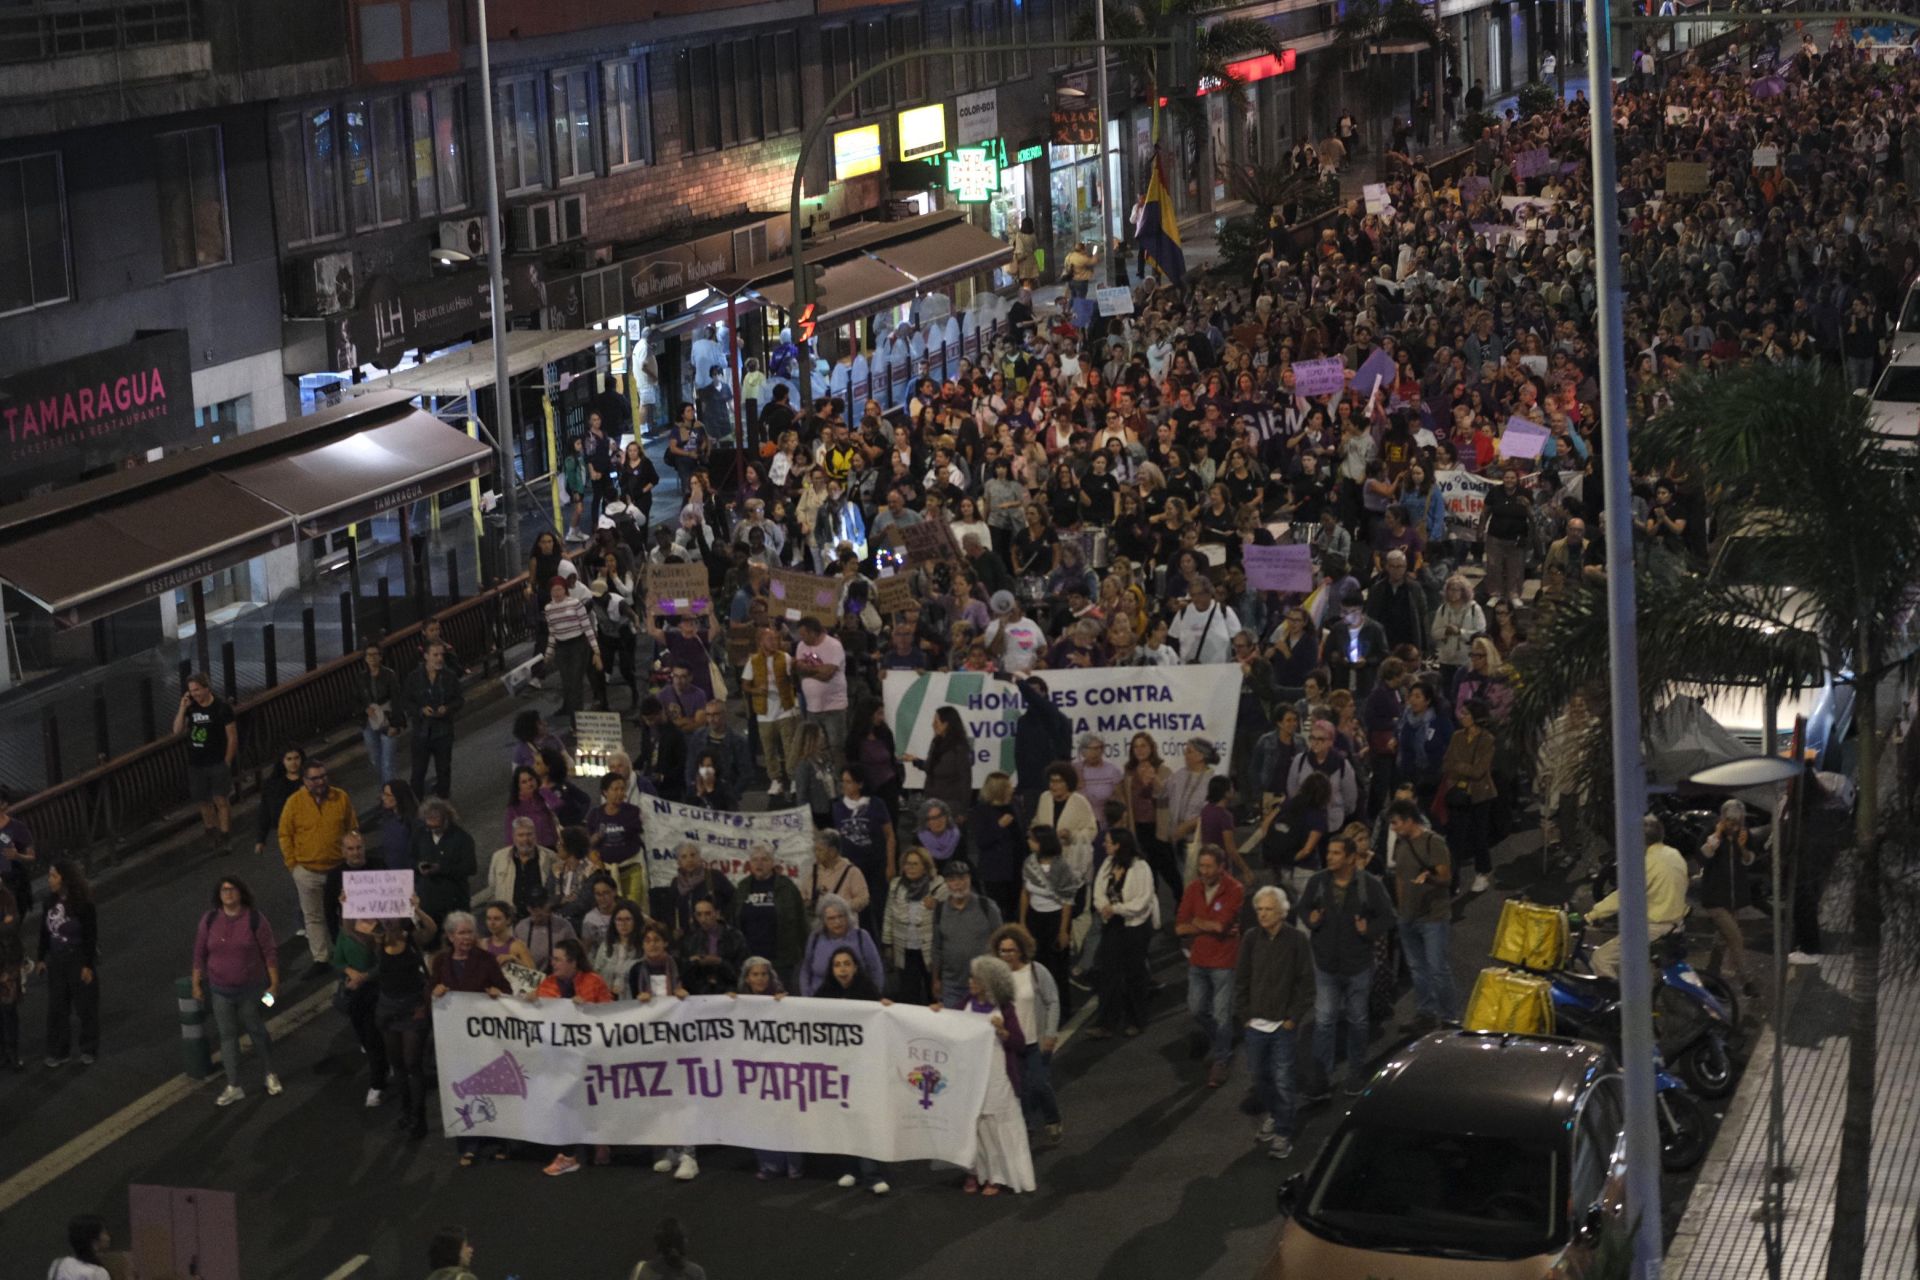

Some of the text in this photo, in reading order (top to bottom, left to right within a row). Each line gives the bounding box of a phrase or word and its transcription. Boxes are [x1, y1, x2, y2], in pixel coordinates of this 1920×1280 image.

[374, 296, 405, 354] JLH
[2, 367, 166, 443] TAMARAGUA
[88, 404, 169, 437] RESTAURANTE
[374, 484, 424, 511] TAMARAGUA
[145, 563, 213, 594] RESTAURANTE
[1085, 685, 1173, 707] CONTRA
[1098, 713, 1206, 732] MACHISTA
[653, 800, 672, 815] NI
[679, 807, 756, 829] CUERPOS
[466, 1016, 864, 1048] CONTRA LAS VIOLENCIAS MACHISTAS
[907, 1046, 949, 1065] RED
[584, 1057, 850, 1112] ¡HAZ TU PARTE!
